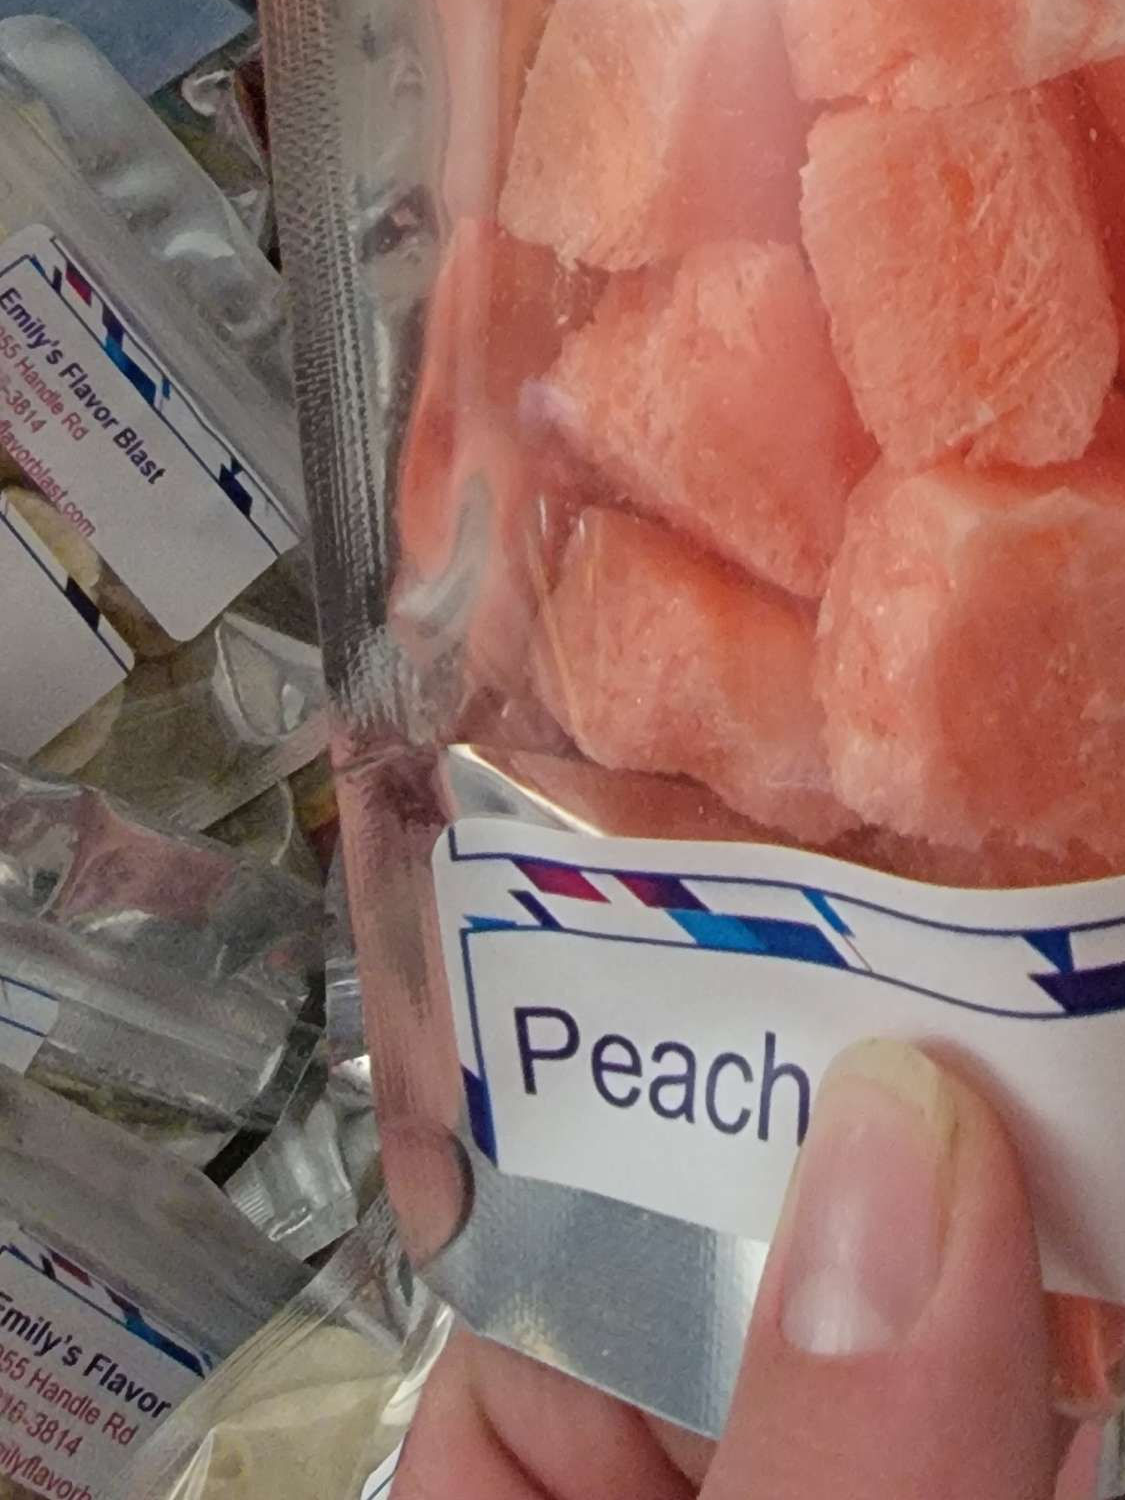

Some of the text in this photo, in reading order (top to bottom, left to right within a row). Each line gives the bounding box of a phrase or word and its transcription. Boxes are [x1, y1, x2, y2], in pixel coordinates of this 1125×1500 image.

[0, 286, 167, 485] Emily's Flavor Blast
[14, 356, 64, 416] Handle
[61, 411, 90, 441] Rd
[513, 1005, 811, 1147] Peach
[26, 1367, 101, 1426] Handle
[101, 1410, 140, 1446] Rd
[82, 1352, 172, 1419] Flavor
